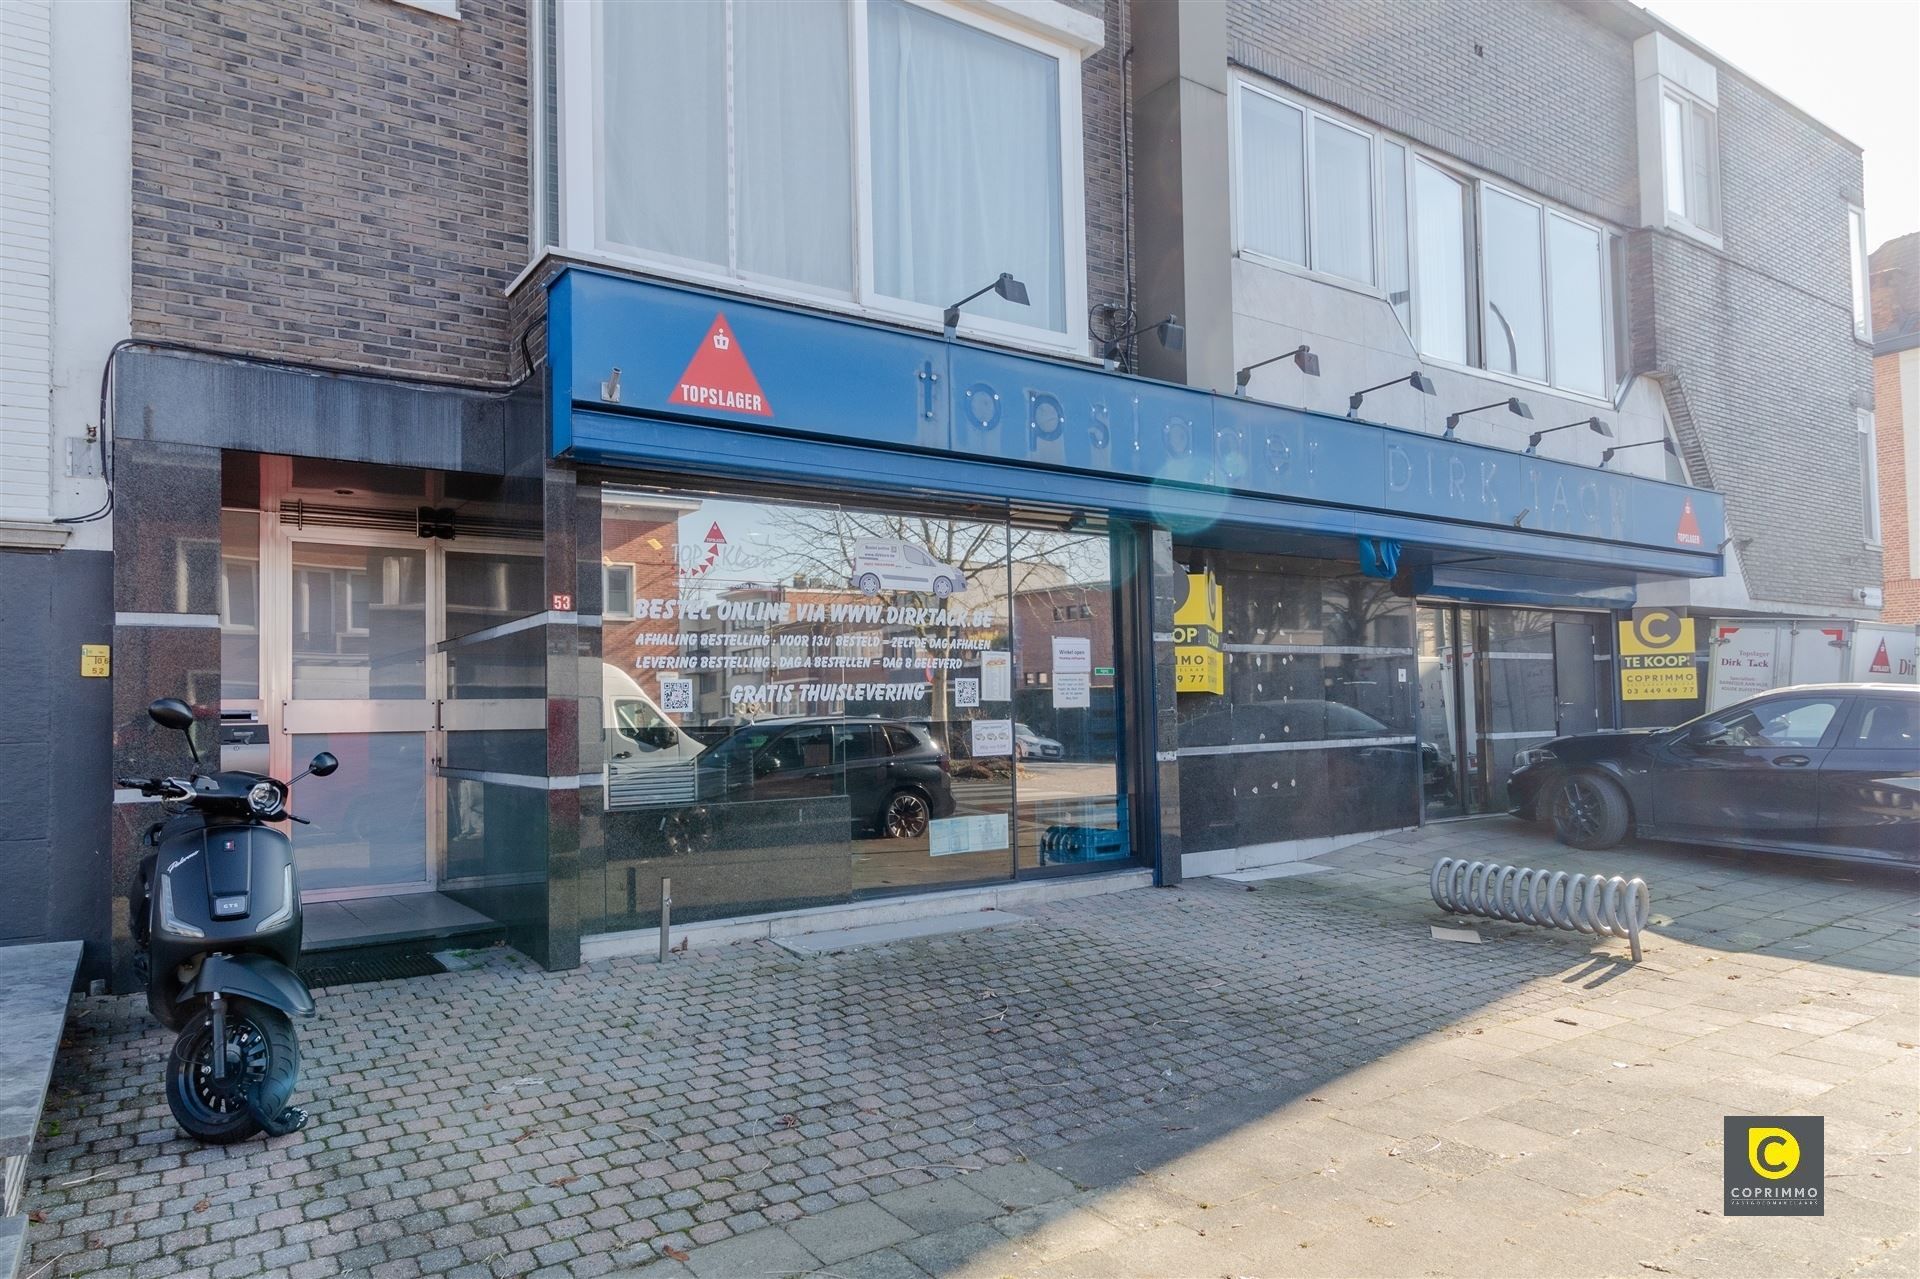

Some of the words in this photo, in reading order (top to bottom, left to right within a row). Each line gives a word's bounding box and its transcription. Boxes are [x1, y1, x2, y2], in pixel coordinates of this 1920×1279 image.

[681, 384, 762, 412] TOPSLAGER
[554, 595, 570, 609] 53
[635, 598, 711, 620] BESTEL
[717, 600, 791, 622] ONLINE
[796, 602, 825, 622] VIA
[830, 603, 993, 628] WWW.DIRKTACK.BE
[635, 633, 697, 646] AFHALING
[700, 634, 770, 646] BESTELLING
[780, 635, 809, 647] VOOR
[836, 635, 880, 647] BESTELD
[891, 636, 927, 648] ZELFDE
[930, 638, 948, 649] DAG
[950, 638, 991, 650] AFHALEN
[1172, 627, 1197, 643] OP
[635, 656, 697, 668] LEVERING
[700, 656, 770, 669] BESTELLING
[780, 656, 802, 668] DAG
[804, 657, 812, 668] A
[814, 656, 871, 668] BESTELLEN
[882, 657, 903, 668] DAG
[914, 657, 963, 669] GELEVERD
[1625, 656, 1640, 667] TE
[1721, 658, 1741, 667] Dirk
[1190, 674, 1204, 683] 77
[1626, 673, 1694, 683] COPRIMMO
[730, 683, 794, 704] GRATIS
[799, 682, 925, 702] THUISLEVERING
